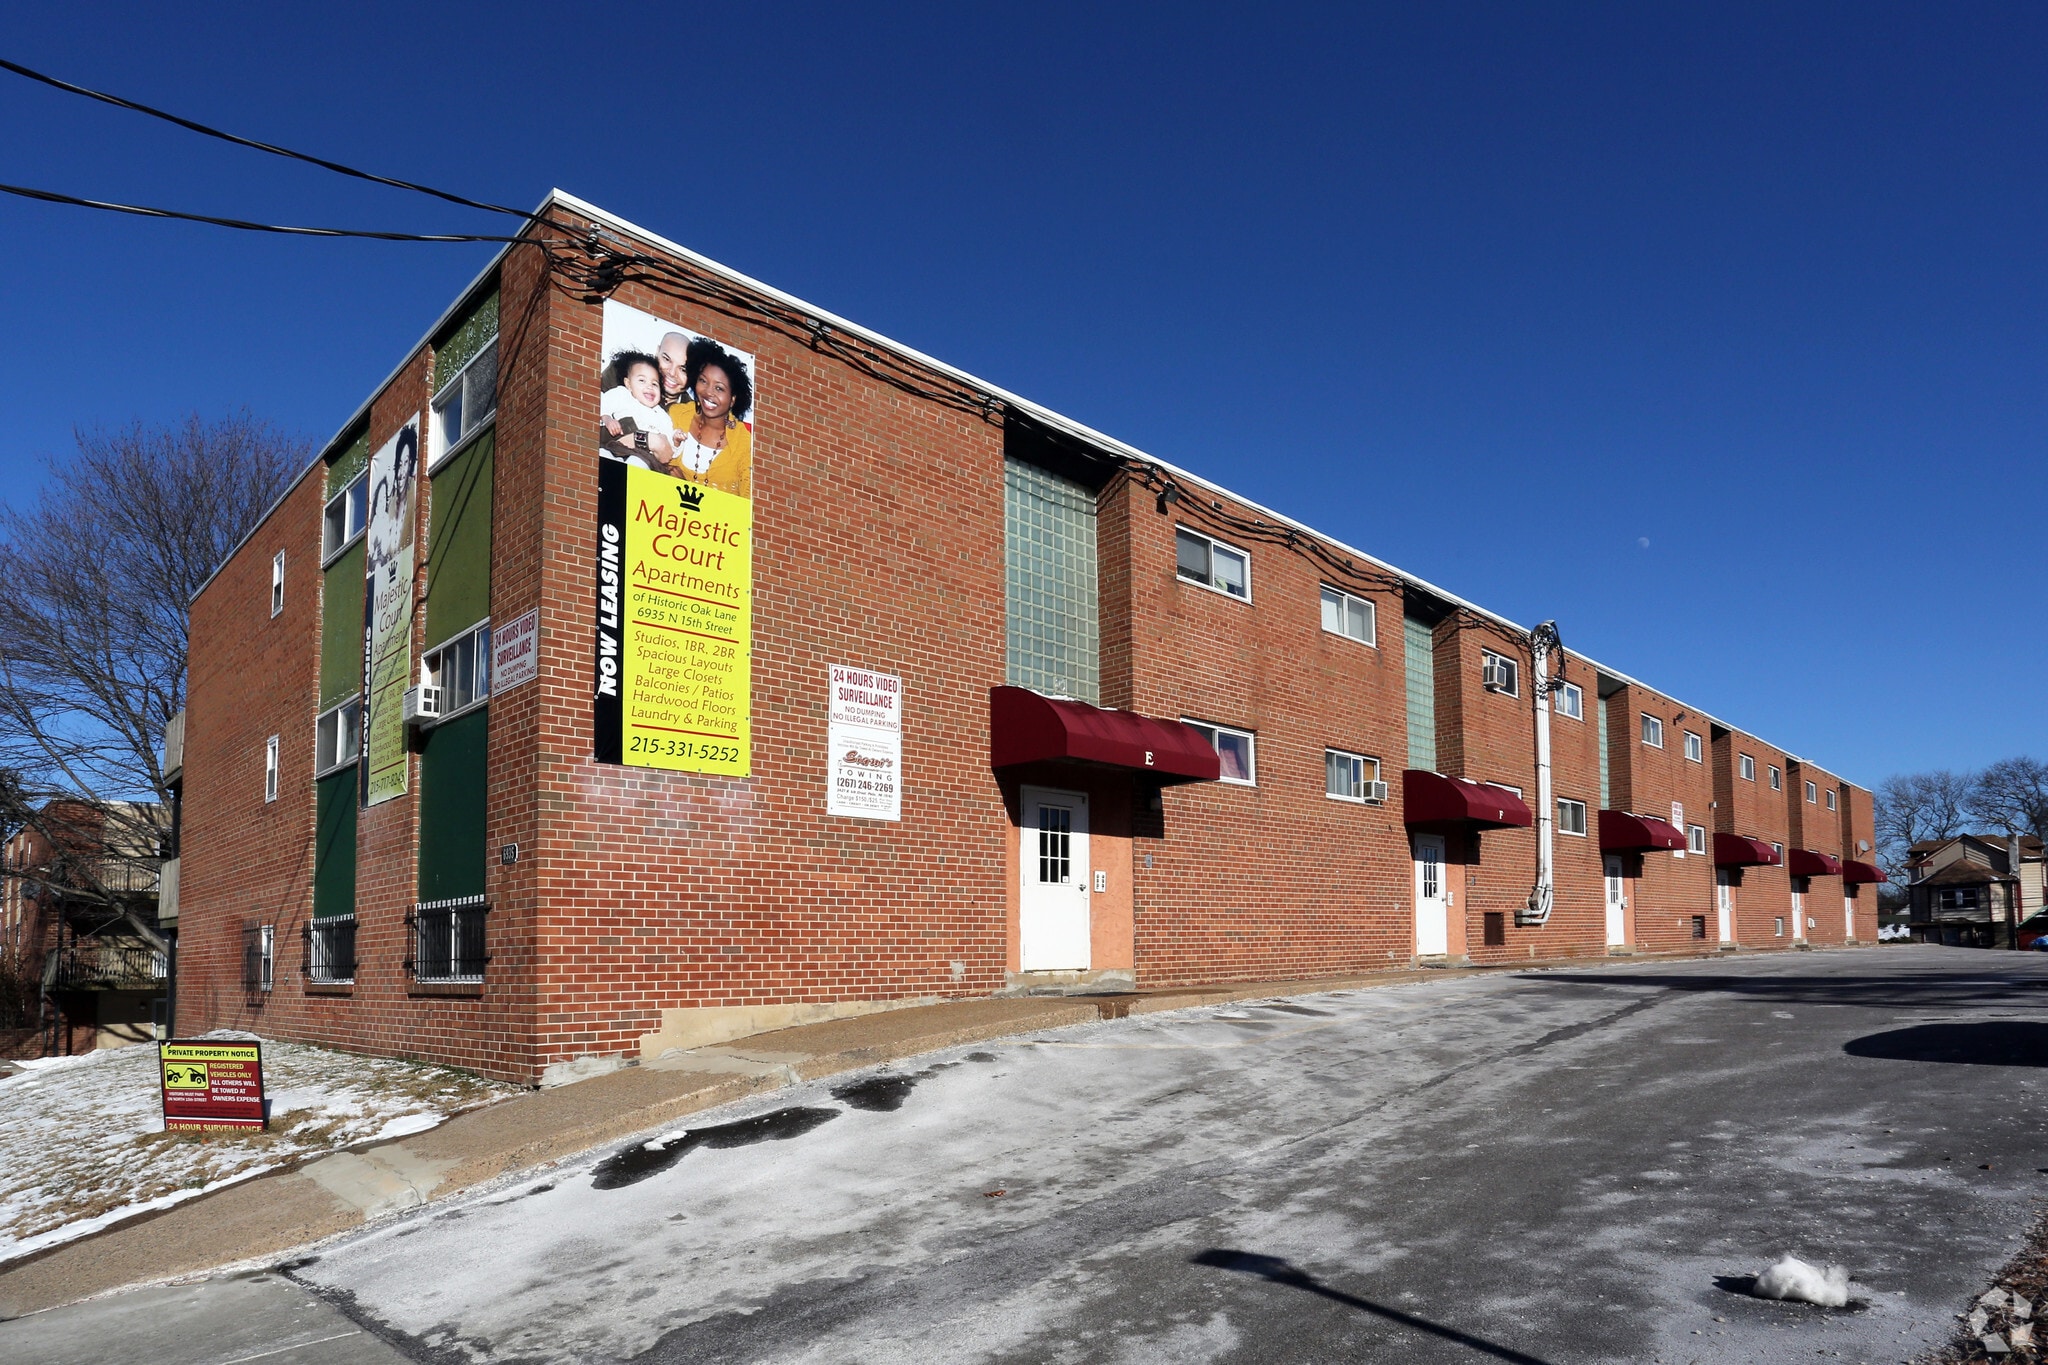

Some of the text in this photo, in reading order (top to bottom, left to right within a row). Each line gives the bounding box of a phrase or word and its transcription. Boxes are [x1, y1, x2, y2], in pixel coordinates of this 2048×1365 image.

[635, 499, 741, 547] Majestic
[652, 533, 726, 571] Court
[632, 560, 740, 599] Apartments
[374, 577, 408, 615] Majestic
[633, 592, 737, 622] of Historic Oak Lane
[379, 602, 404, 633] Court
[600, 523, 620, 697] NOW LEASING
[637, 607, 733, 635] 6935 N 15th Street
[495, 614, 536, 649] 24 HOURS VIDEO
[634, 630, 736, 659] Studios, 1BR, 2BR
[496, 636, 532, 668] SURVEILLANCE
[636, 645, 733, 673] Spacious Layouts
[500, 659, 527, 677] NO DUMPING
[516, 665, 535, 682] PARKING
[648, 662, 723, 685] Large Closets
[833, 668, 898, 693] 24 HOURS VIDEO
[362, 626, 372, 757] NOW LEASING
[635, 675, 690, 694] Balconies
[702, 685, 734, 701] Patios
[838, 686, 893, 710] SURVEILLANCE
[632, 689, 736, 716] Hardwood Floors
[845, 705, 886, 719] NO DUMPING
[631, 705, 738, 733] Laundry & Parking
[833, 712, 898, 729] NO ILLEGAL PARKING
[630, 736, 739, 763] 215-331-5252
[1145, 751, 1154, 766] E
[837, 777, 857, 788] (267)
[857, 780, 894, 794] 246-2269
[838, 768, 893, 782] TOWING
[1499, 809, 1505, 820] F
[167, 1049, 255, 1058] PRIVATE PROPERTY NOTICE
[209, 1062, 244, 1070] REGISTERED
[168, 1123, 263, 1133] 24 HOUR SURVEILLANCE
